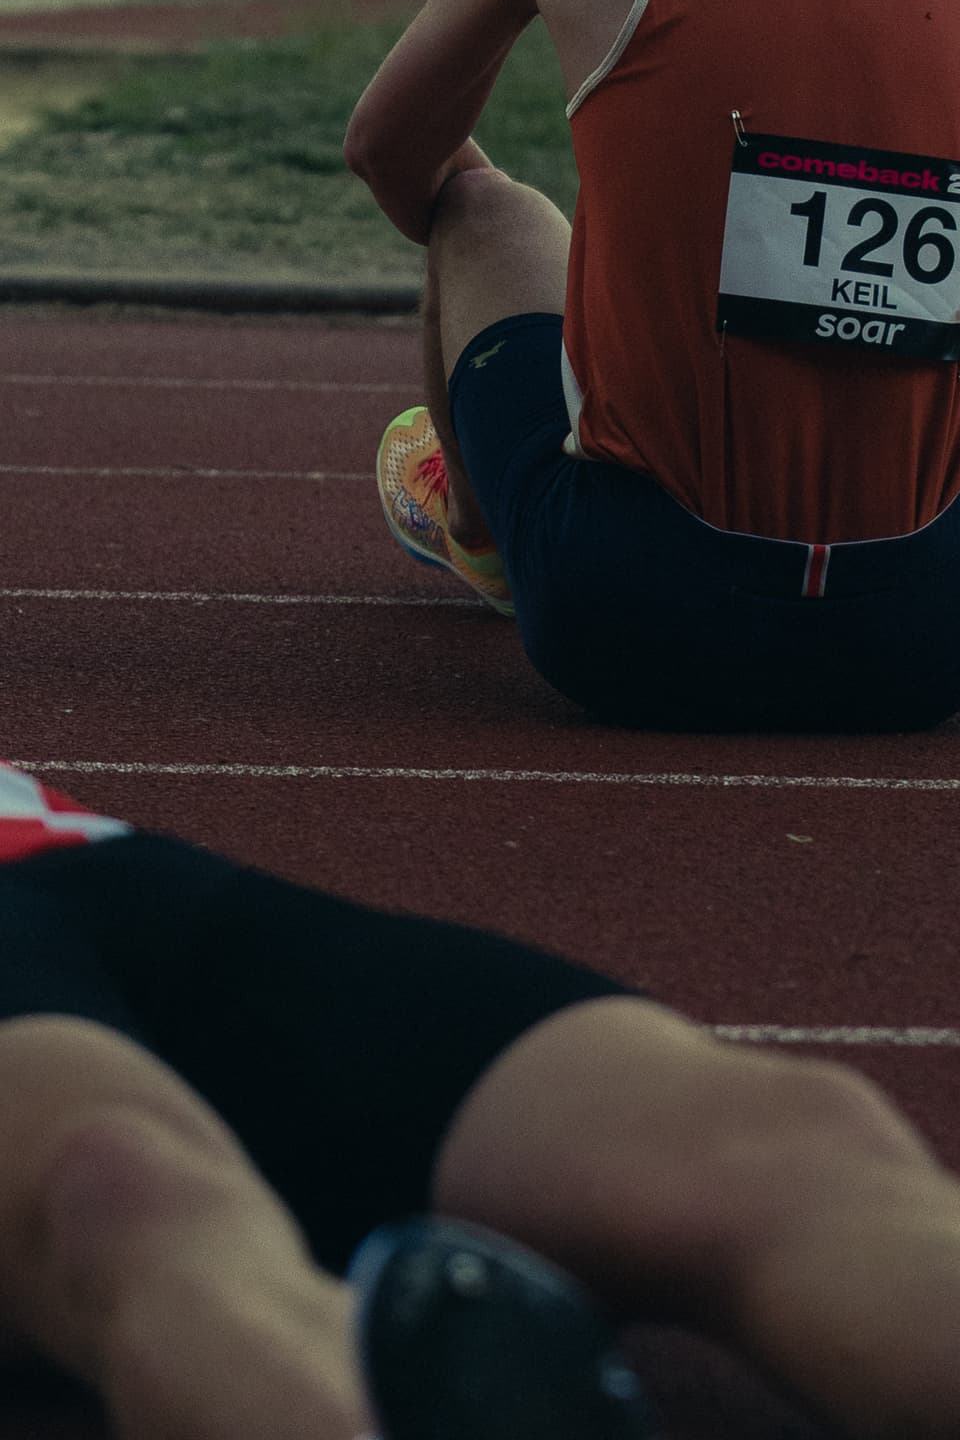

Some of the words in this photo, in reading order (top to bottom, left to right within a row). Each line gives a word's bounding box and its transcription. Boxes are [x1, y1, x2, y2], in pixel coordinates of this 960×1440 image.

[758, 151, 940, 191] comeback
[790, 191, 957, 284] 126
[831, 278, 897, 309] KEIL
[815, 313, 905, 345] soar
